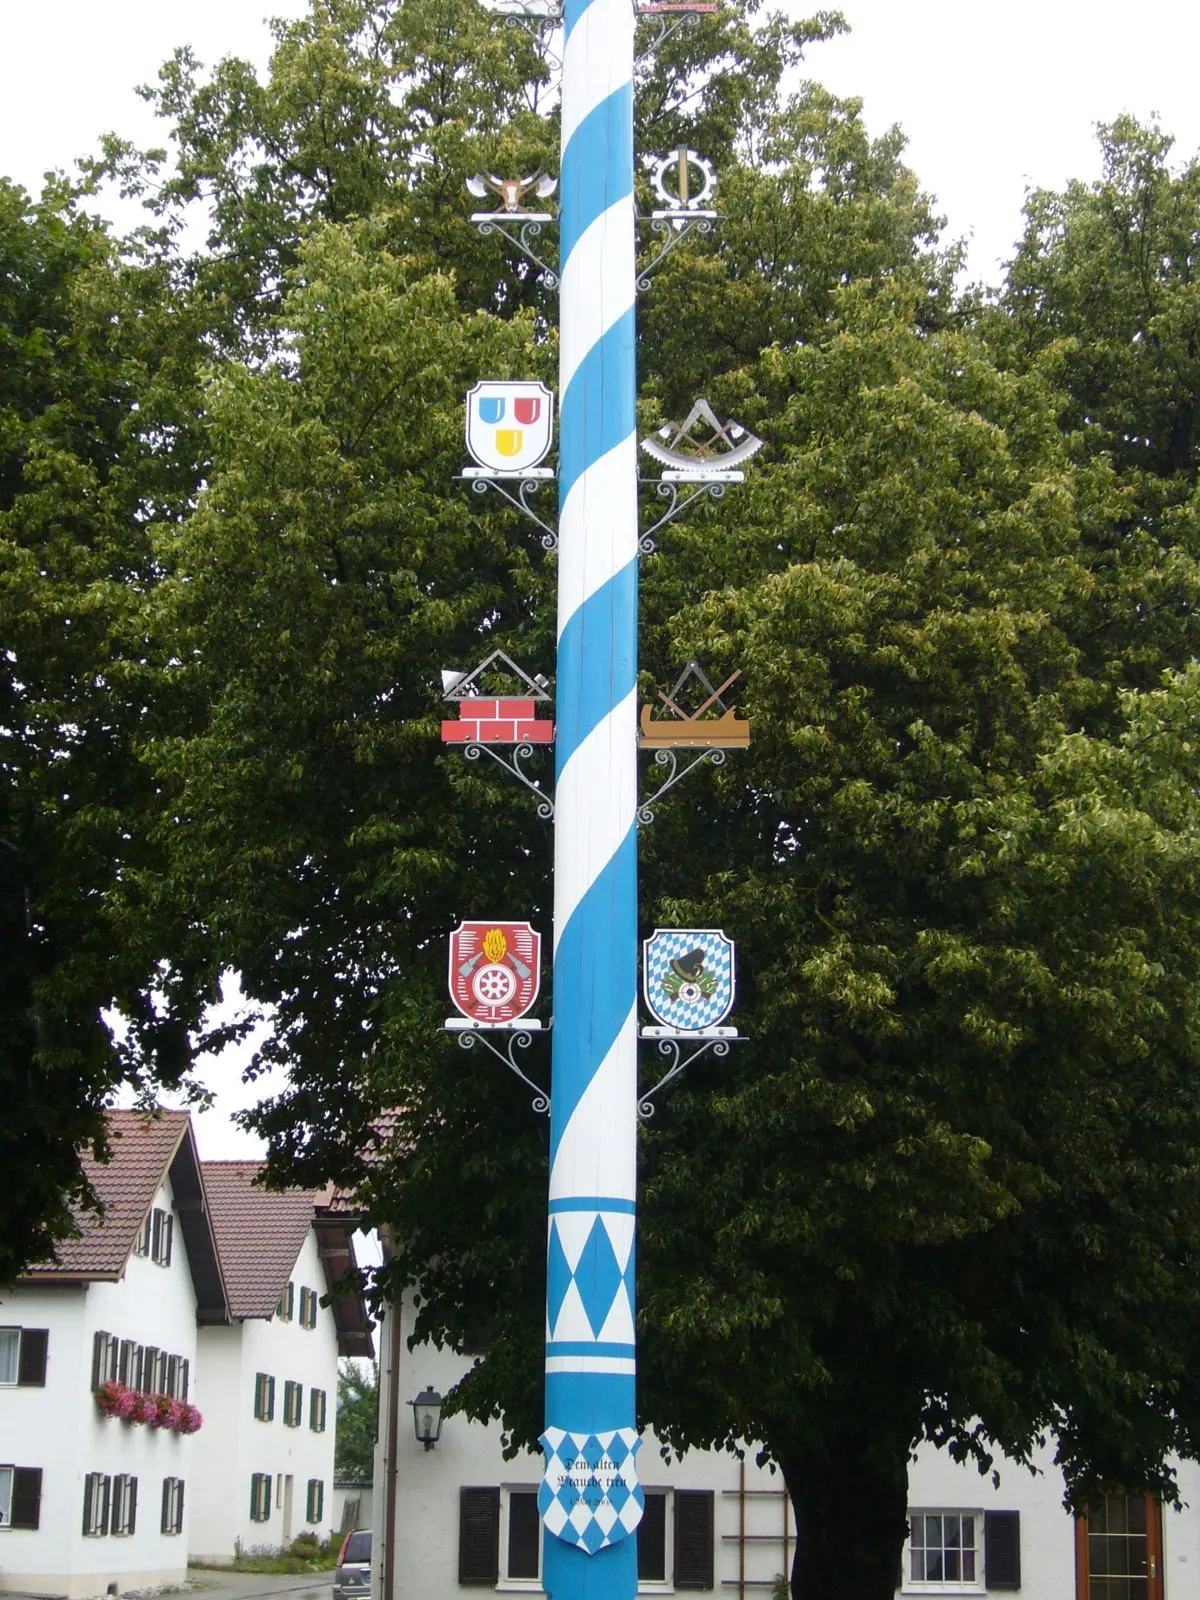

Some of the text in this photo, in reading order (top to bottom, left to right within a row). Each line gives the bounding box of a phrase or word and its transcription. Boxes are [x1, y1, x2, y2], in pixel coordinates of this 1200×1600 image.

[564, 1458, 619, 1470] Dem alten
[606, 1478, 626, 1488] treu
